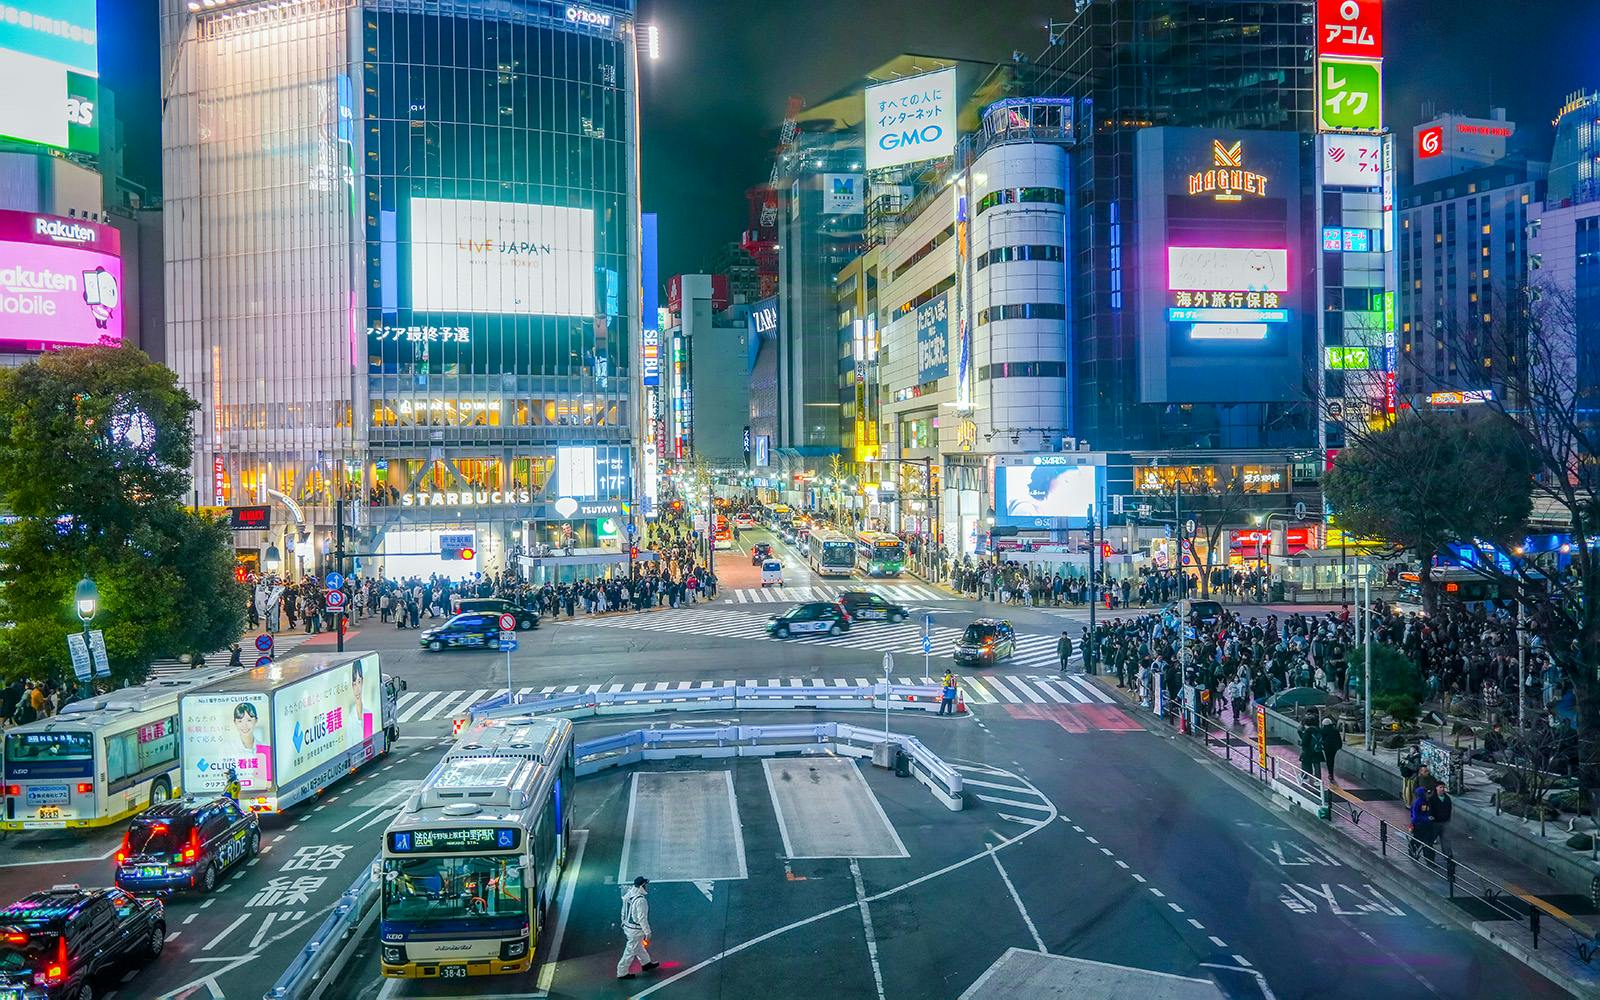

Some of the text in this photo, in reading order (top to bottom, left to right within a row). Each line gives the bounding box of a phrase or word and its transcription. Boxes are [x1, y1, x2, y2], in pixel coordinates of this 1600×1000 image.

[1325, 24, 1375, 46] アコム
[879, 89, 942, 113] すべての人に
[878, 105, 942, 128] インターネット
[879, 124, 943, 151] GMO
[1189, 169, 1268, 197] MAGNET
[36, 218, 96, 243] Rakuten
[459, 238, 551, 256] LIVE JAPAN
[1176, 291, 1279, 308] 海外旅行保険
[644, 329, 658, 377] SEIBU
[608, 476, 626, 490] 7F
[401, 491, 531, 507] STARBUCKS
[581, 505, 618, 514] TSUTAYA
[326, 707, 342, 735] 看護
[304, 722, 326, 746] CLIUS
[210, 762, 237, 771] CLIUS
[238, 758, 259, 769] 看護
[327, 763, 342, 780] CLIUS
[459, 829, 494, 842] 中野駅
[443, 968, 466, 978] 38-43
